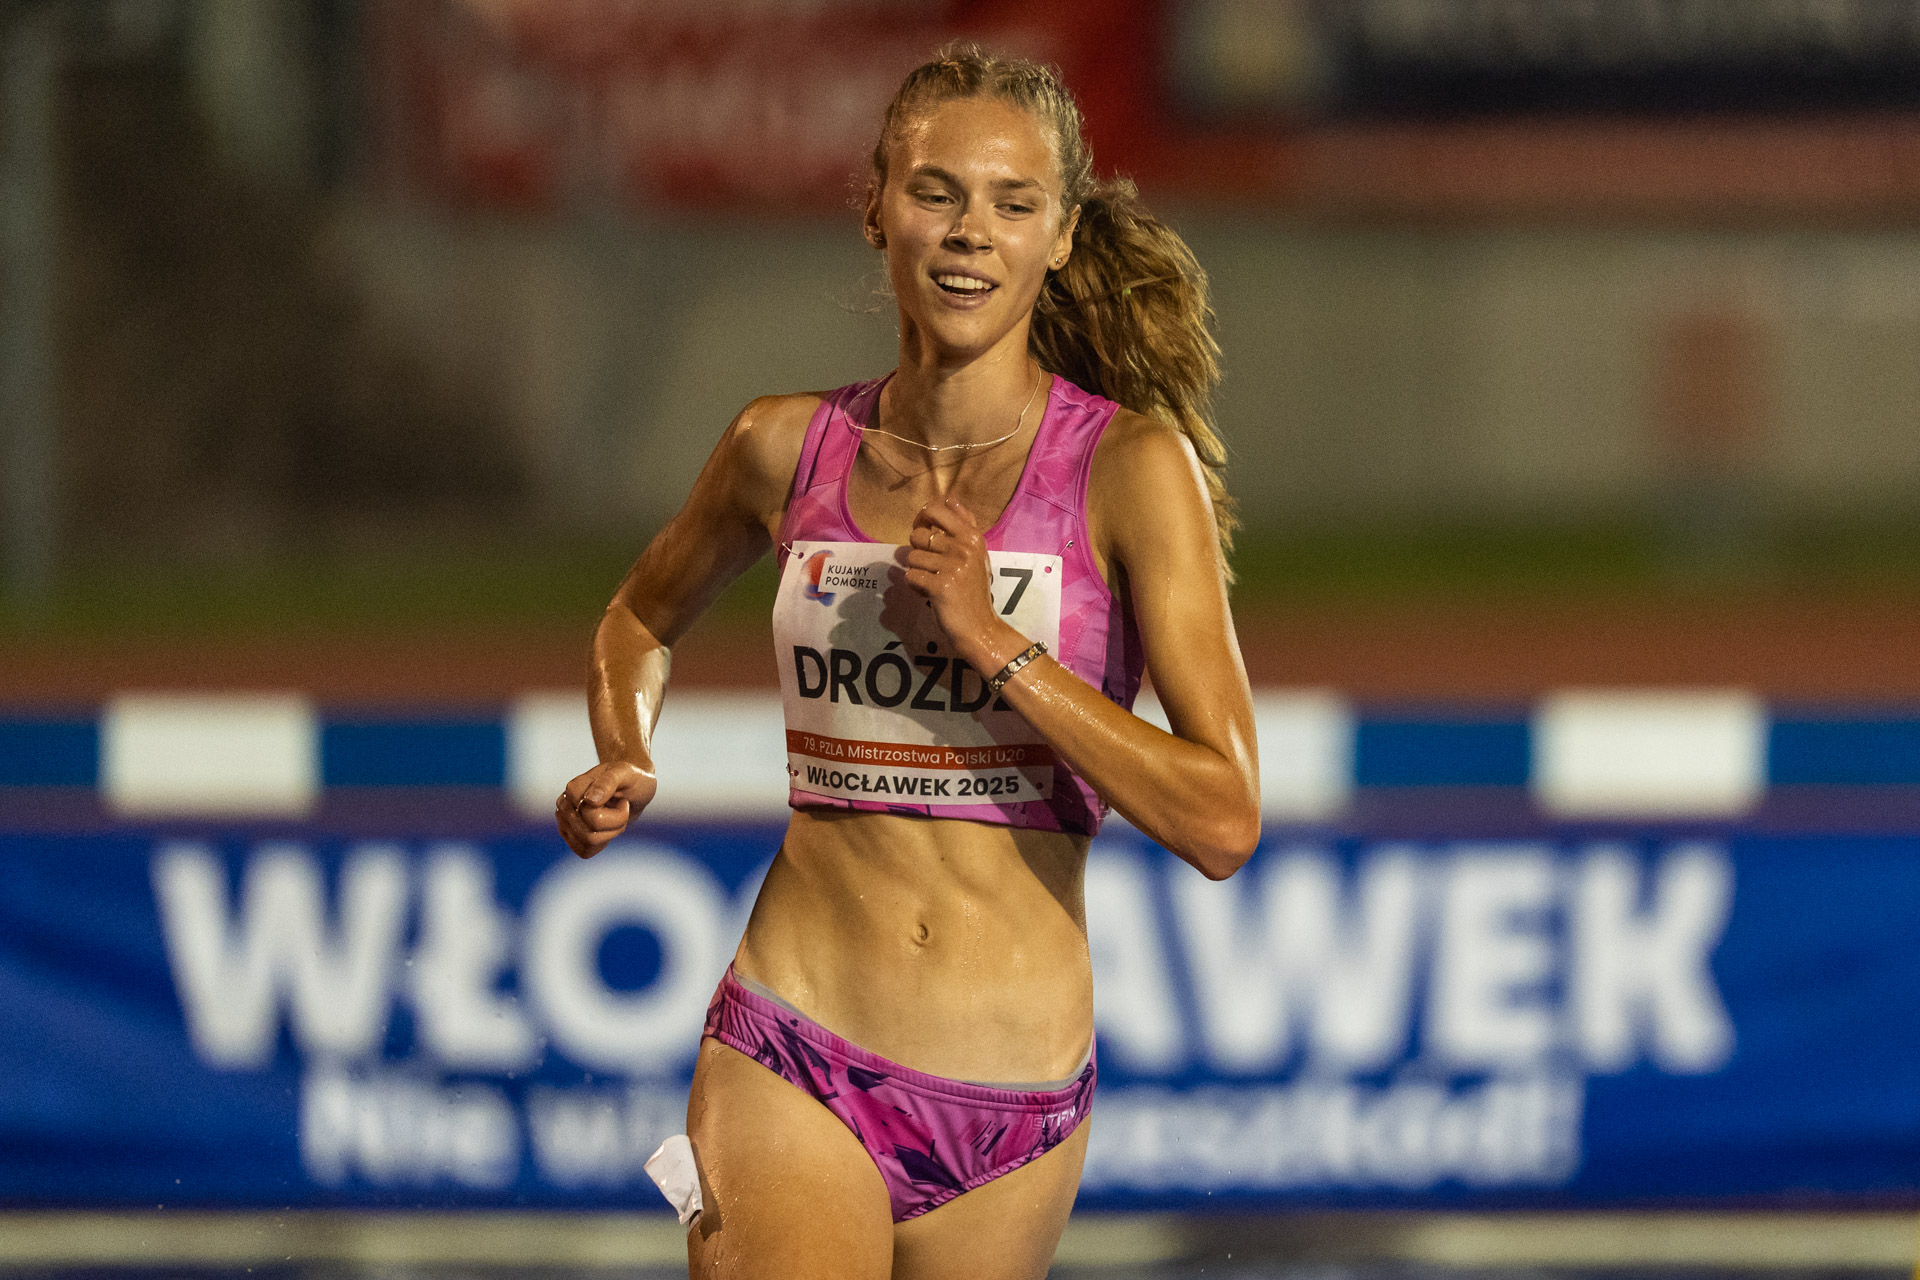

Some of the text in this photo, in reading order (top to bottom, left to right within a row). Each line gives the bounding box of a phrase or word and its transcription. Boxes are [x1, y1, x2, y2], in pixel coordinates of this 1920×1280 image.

[825, 576, 878, 589] POMORZE
[828, 565, 870, 576] KUJAWY
[793, 641, 1013, 713] DRÓŻD
[803, 736, 1025, 765] 79. PZLA Mistrzostwa Polski U20
[807, 765, 1020, 797] WŁOCŁAWEK 2025
